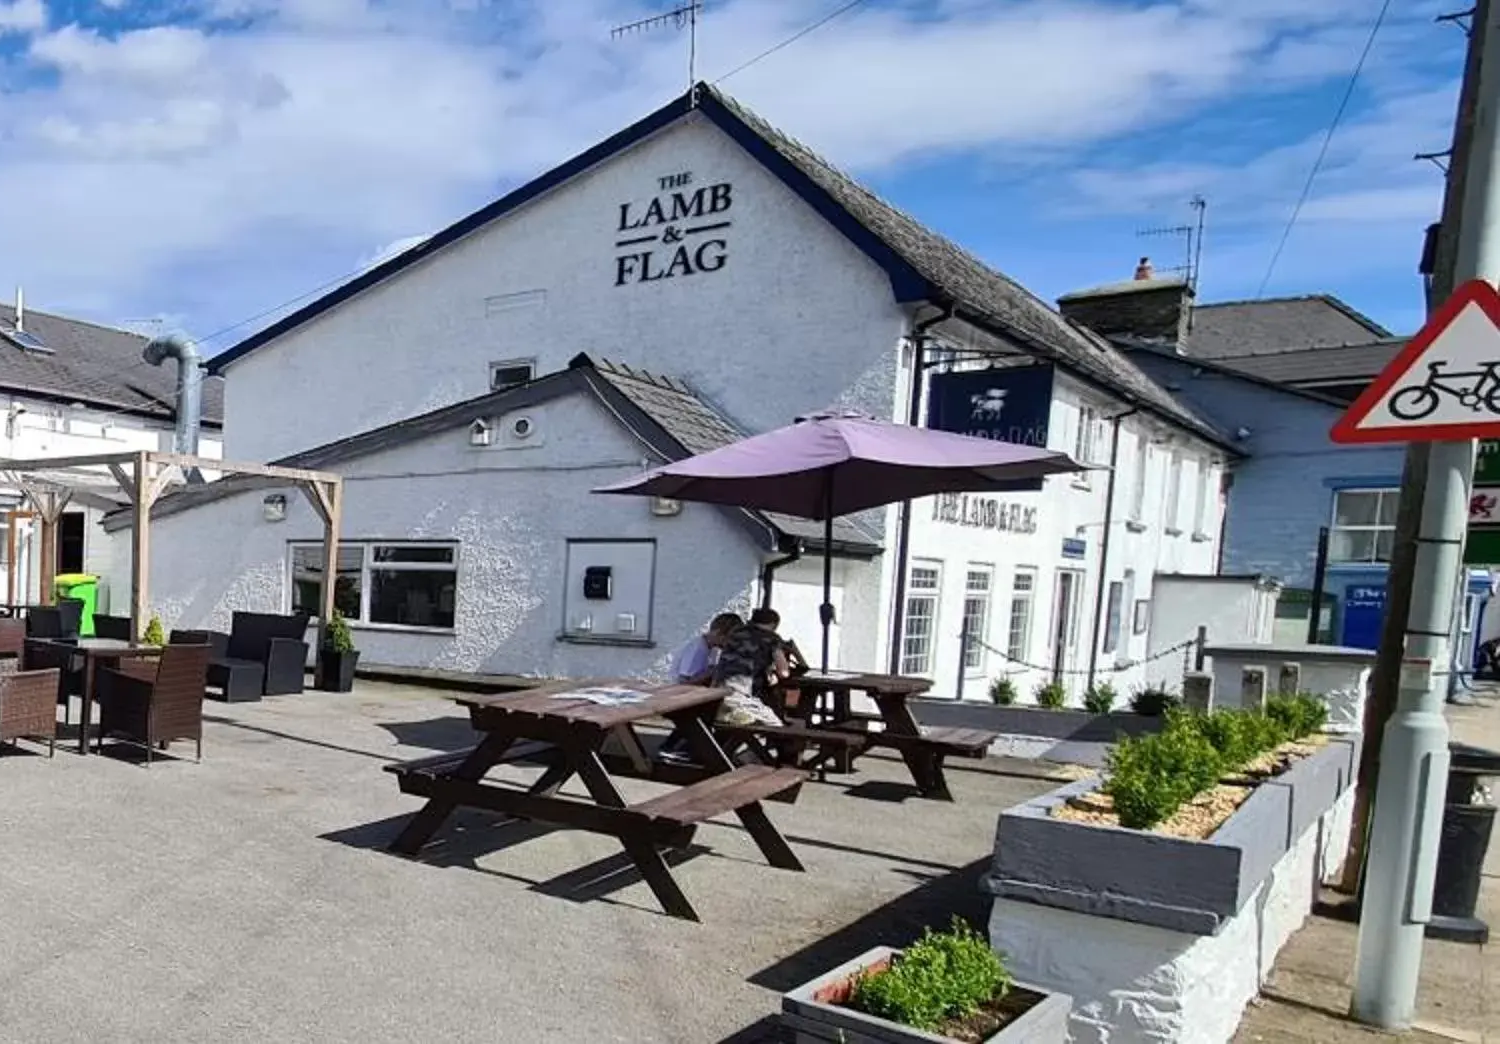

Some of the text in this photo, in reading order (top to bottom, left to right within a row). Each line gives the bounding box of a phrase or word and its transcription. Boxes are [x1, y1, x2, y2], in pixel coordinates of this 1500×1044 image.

[658, 172, 693, 190] THE
[618, 183, 733, 231] LAMB
[662, 225, 683, 246] &
[614, 239, 728, 287] FLAG
[931, 492, 958, 523] THE
[959, 495, 998, 529] LAMB
[1007, 503, 1038, 535] FLAG
